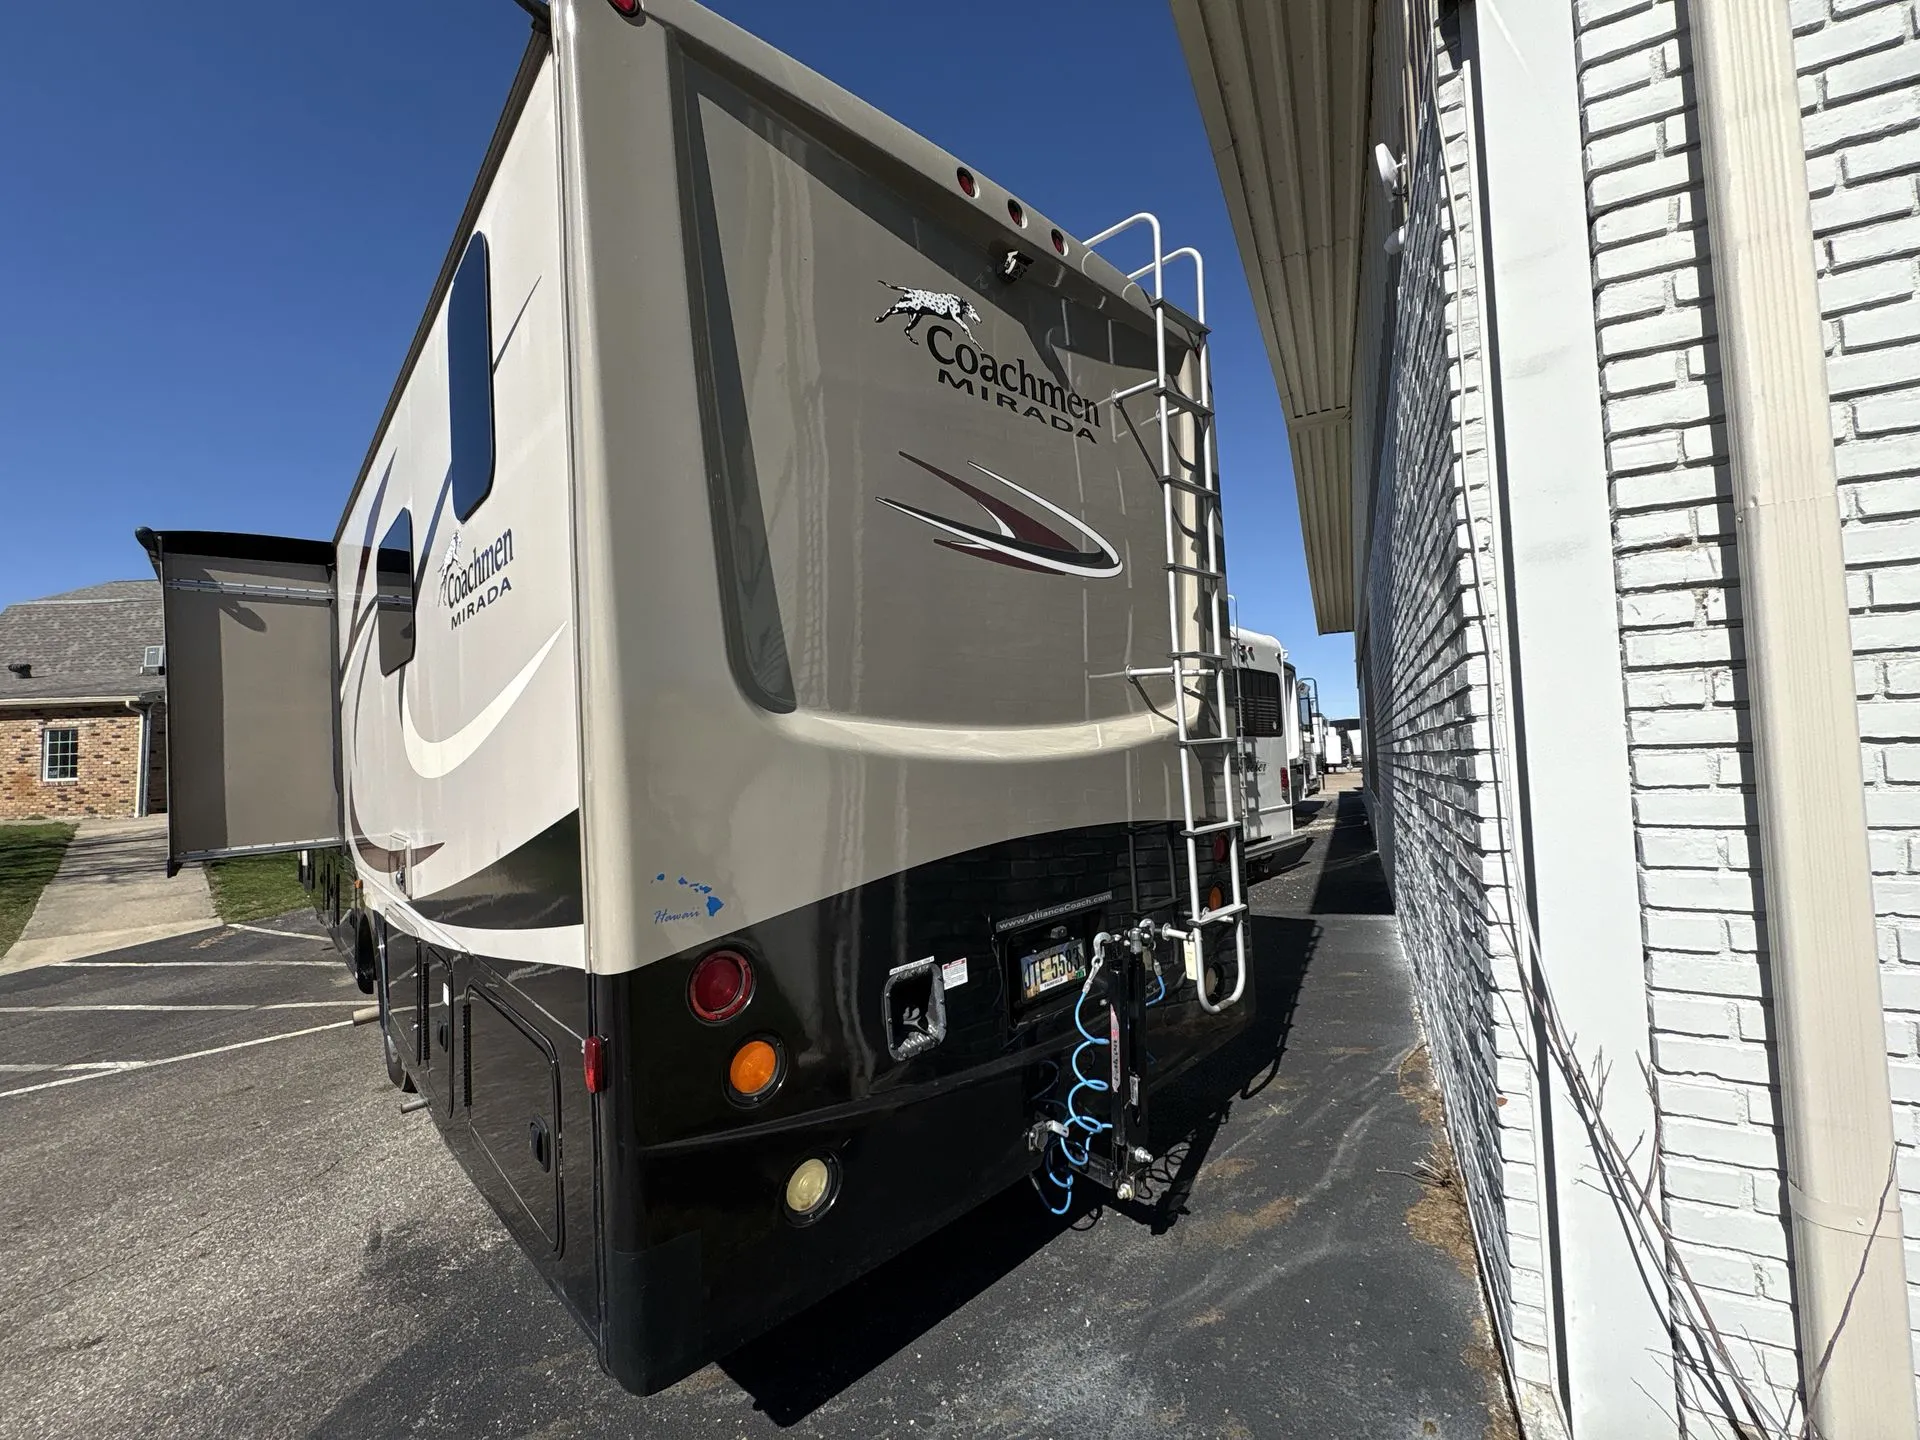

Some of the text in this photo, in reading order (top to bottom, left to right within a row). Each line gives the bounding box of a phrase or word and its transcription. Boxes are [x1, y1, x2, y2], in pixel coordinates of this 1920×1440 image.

[926, 325, 1100, 428] Coachmen
[938, 368, 1098, 444] MIRADA
[447, 528, 514, 609] Coachmen
[451, 576, 512, 630] MIRADA
[999, 893, 1111, 930] www.AllianceCoach.com
[1023, 957, 1048, 989] JTE
[1050, 947, 1080, 980] 5583
